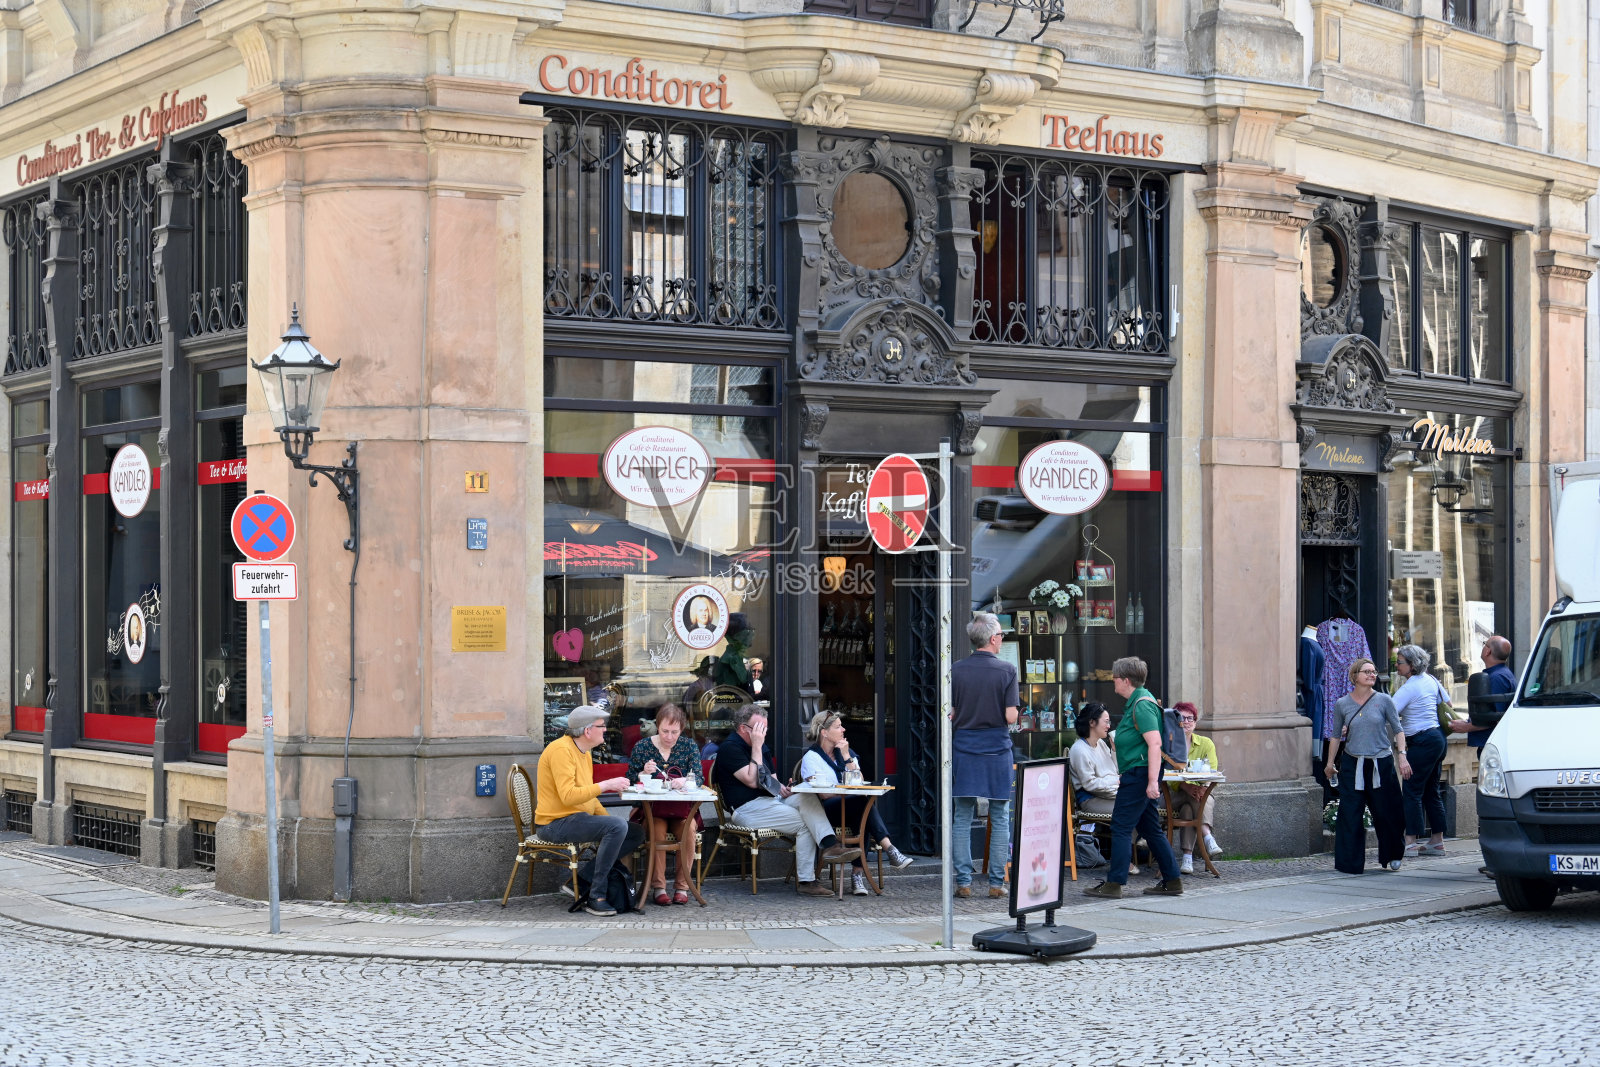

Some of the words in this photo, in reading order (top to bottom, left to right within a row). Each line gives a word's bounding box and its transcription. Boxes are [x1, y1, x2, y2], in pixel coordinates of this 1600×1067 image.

[539, 54, 733, 110] Conditorei
[1042, 113, 1164, 158] Teehaus
[17, 134, 83, 186] Conditorei
[86, 127, 116, 162] Tee-
[118, 114, 136, 149] &
[210, 464, 220, 478] Tee
[221, 463, 228, 477] &
[616, 454, 699, 480] KANDLER
[1029, 466, 1098, 490] KANDLER
[114, 469, 147, 493] KANDLER
[469, 474, 485, 489] 11
[819, 491, 868, 520] Kaffe
[241, 569, 289, 580] Feuerwehr-
[251, 583, 281, 594] zufahrt
[1556, 771, 1600, 785] IVEC
[1557, 856, 1574, 870] KS
[1582, 856, 1599, 870] AM
